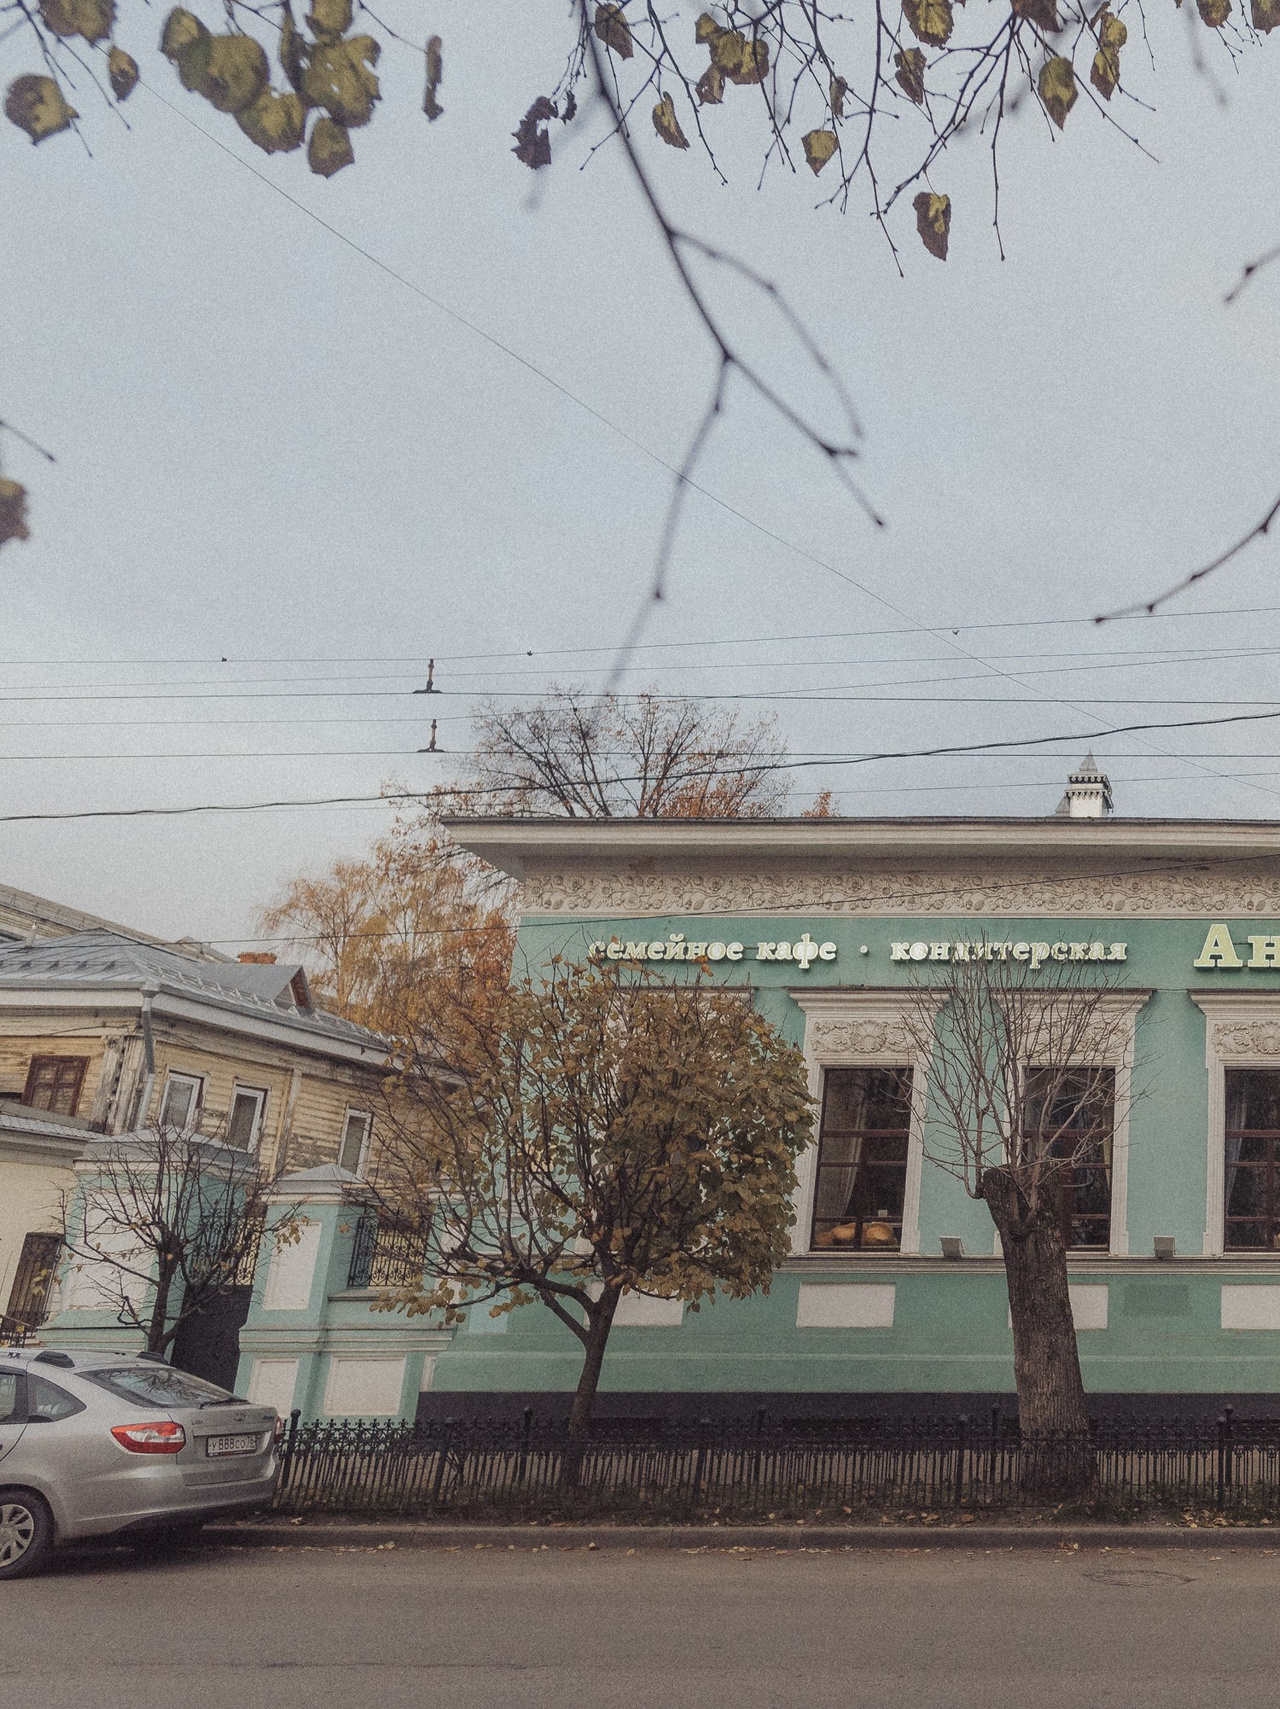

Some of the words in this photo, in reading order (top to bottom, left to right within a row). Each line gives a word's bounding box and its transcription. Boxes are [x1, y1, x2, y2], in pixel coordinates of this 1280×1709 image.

[589, 933, 744, 961] семейное
[756, 933, 837, 969] кафе
[890, 941, 1128, 969] кондитерская
